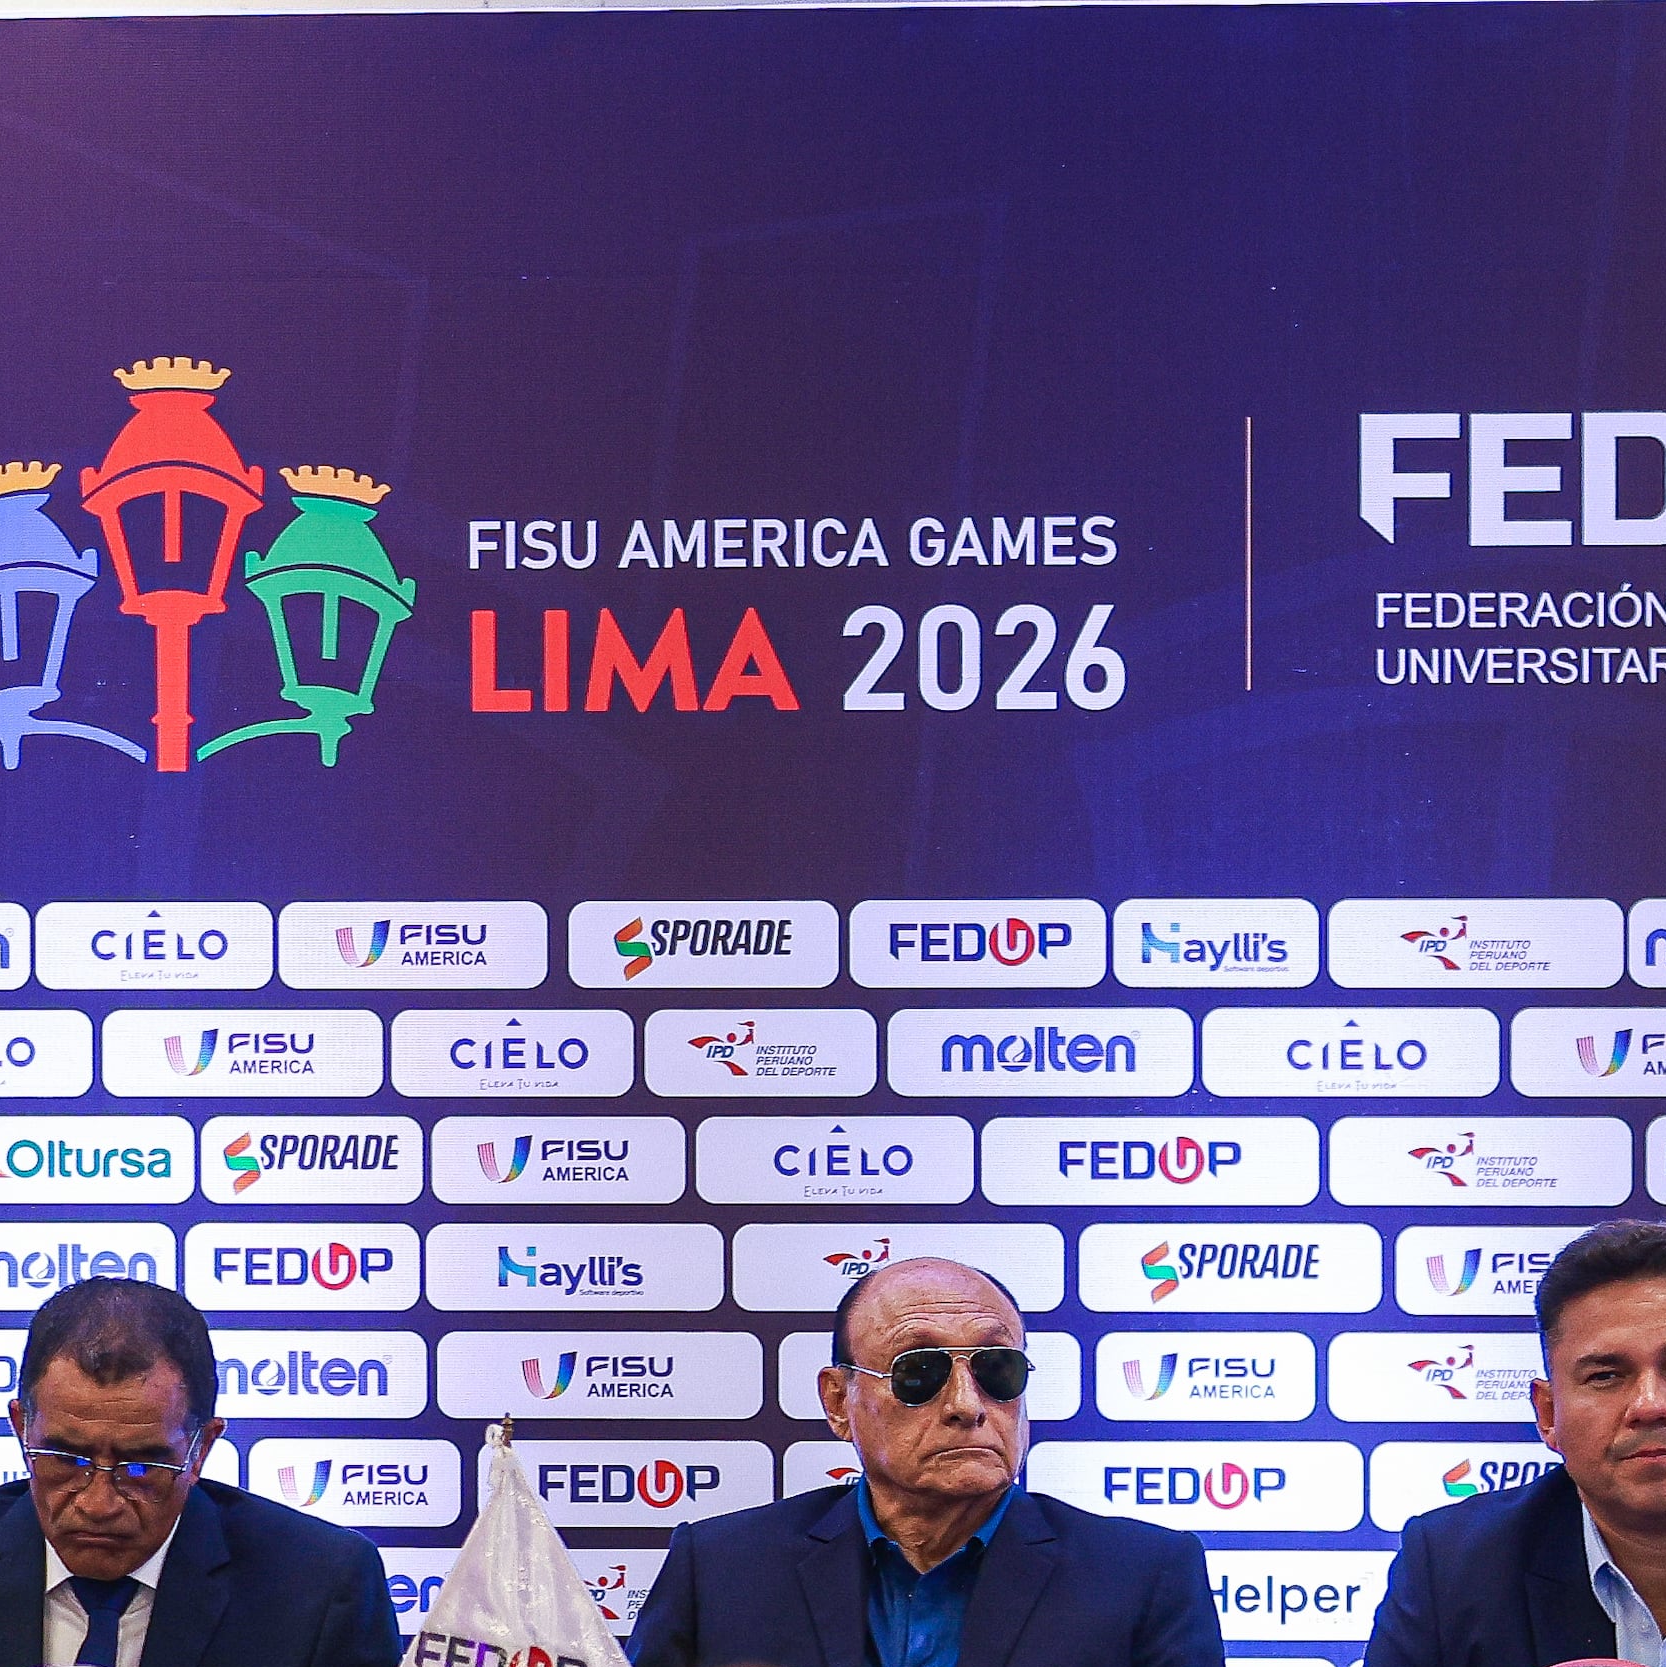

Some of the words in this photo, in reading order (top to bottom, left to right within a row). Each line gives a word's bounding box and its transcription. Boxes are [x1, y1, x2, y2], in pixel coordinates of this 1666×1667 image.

[468, 520, 598, 569] FISU
[618, 518, 888, 568] AMERICA
[909, 516, 1118, 567] GAMES
[471, 607, 801, 713] LIMA
[841, 603, 1128, 712] 2026
[400, 925, 487, 945] FISU
[651, 920, 792, 956] SPORADE
[401, 951, 487, 965] AMERICA
[229, 1033, 314, 1054] FISU
[756, 1046, 817, 1054] INSTITUTO
[942, 1027, 1135, 1073] molten
[230, 1060, 314, 1074] AMERICA
[6, 1140, 171, 1178] Oltursa
[260, 1135, 399, 1170] SPORADE
[541, 1140, 628, 1161] FISU
[543, 1167, 629, 1181] AMERICA
[1179, 1244, 1319, 1279] SPORADE
[586, 1356, 673, 1377] FISU
[1189, 1358, 1275, 1377] FISU
[587, 1383, 674, 1397] AMERICA
[1190, 1385, 1275, 1398] AMERICA
[342, 1465, 428, 1485] FISU
[344, 1491, 428, 1505] AMERICA
